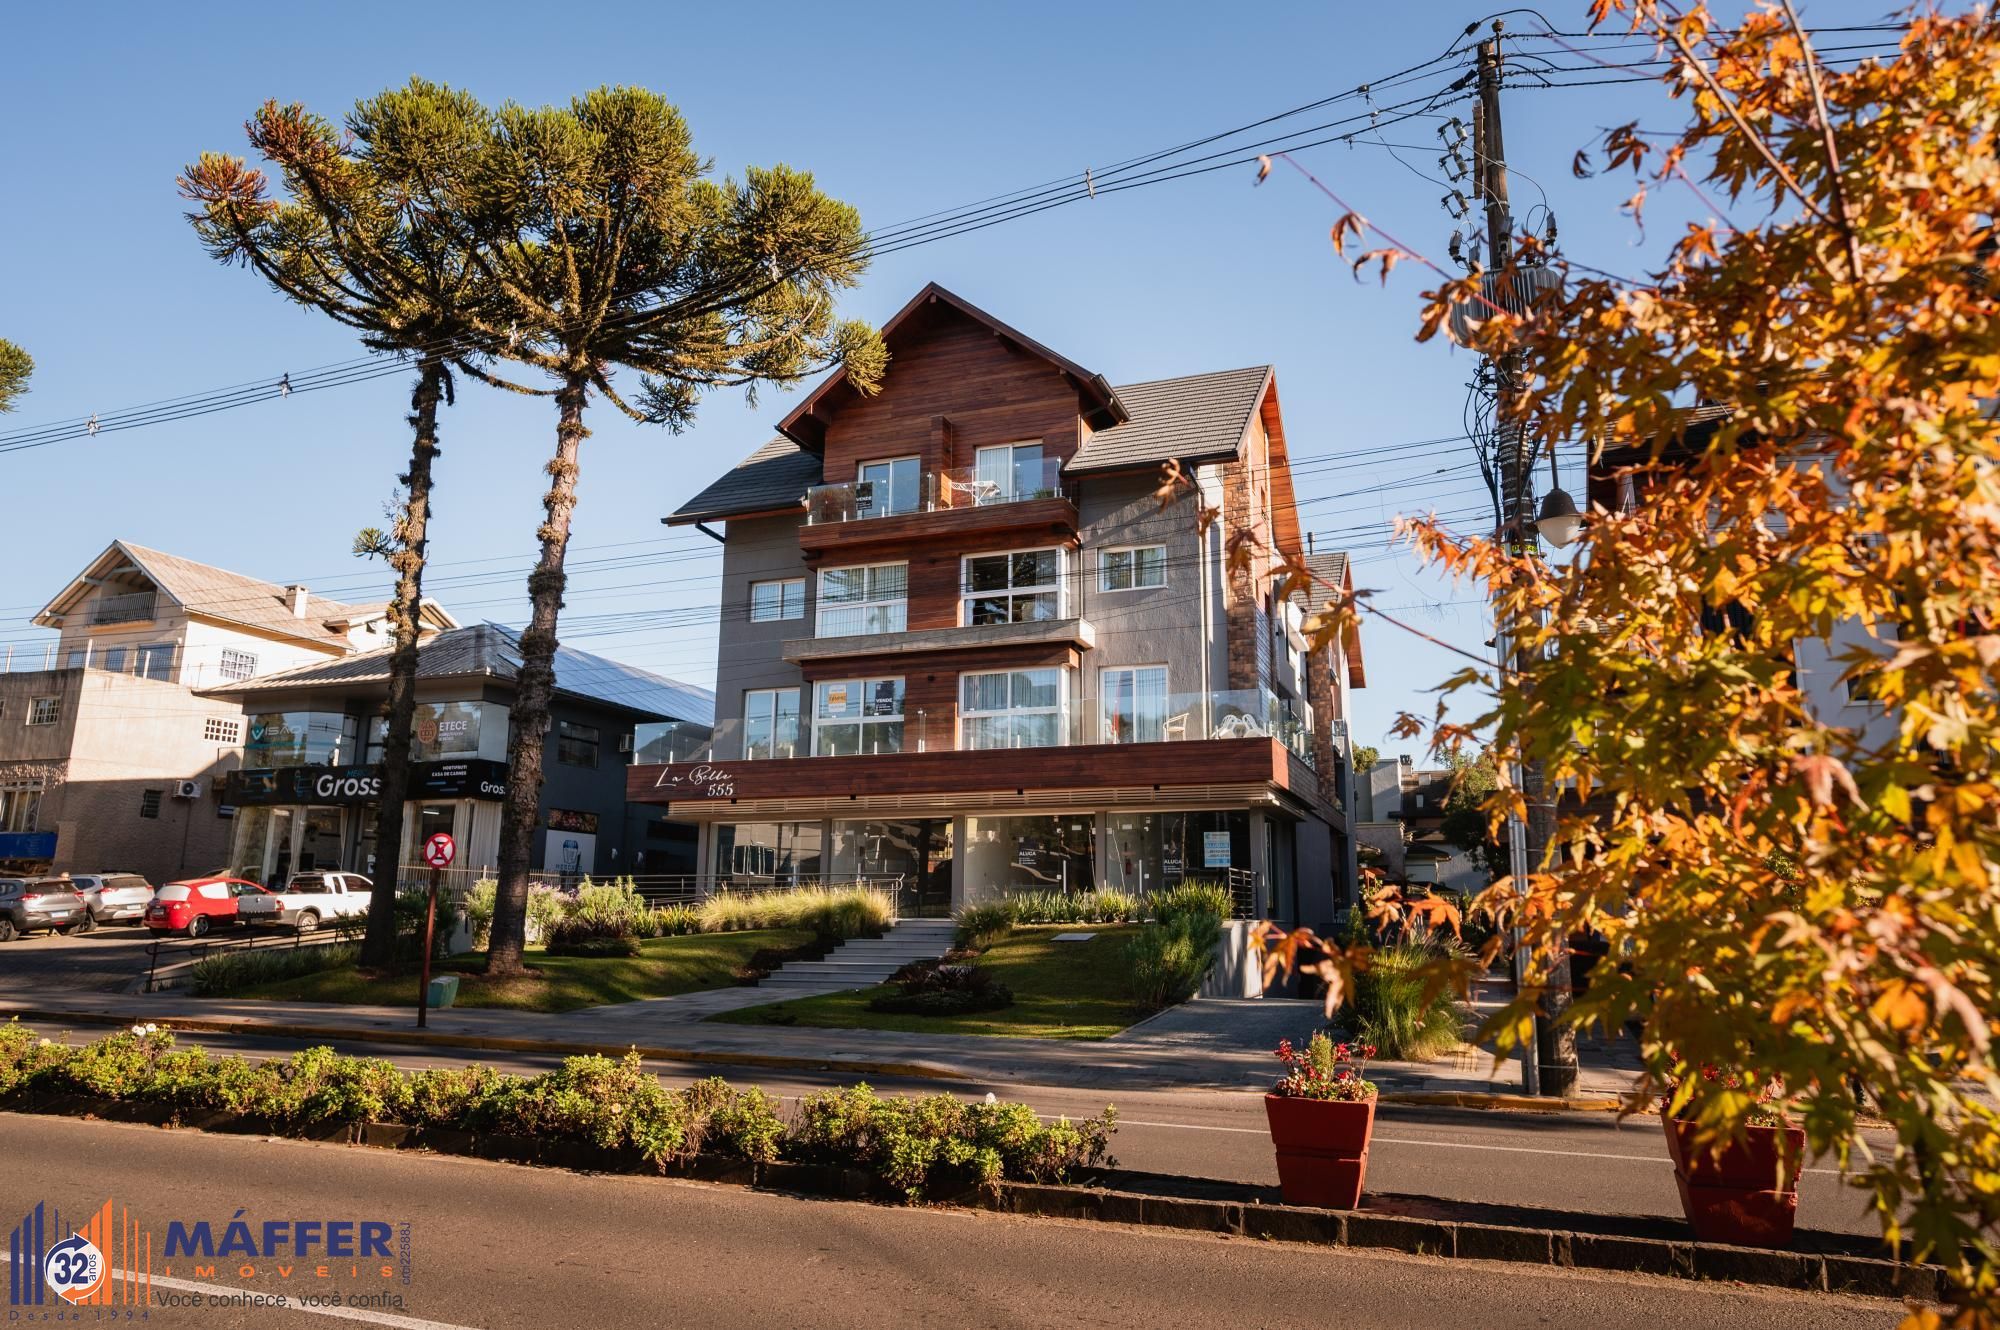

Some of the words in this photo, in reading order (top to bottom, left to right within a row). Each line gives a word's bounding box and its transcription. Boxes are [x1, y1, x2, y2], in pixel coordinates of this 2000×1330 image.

[439, 720, 467, 731] ETECE
[654, 766, 684, 787] La
[481, 781, 506, 795] Gros
[707, 783, 734, 796] 555
